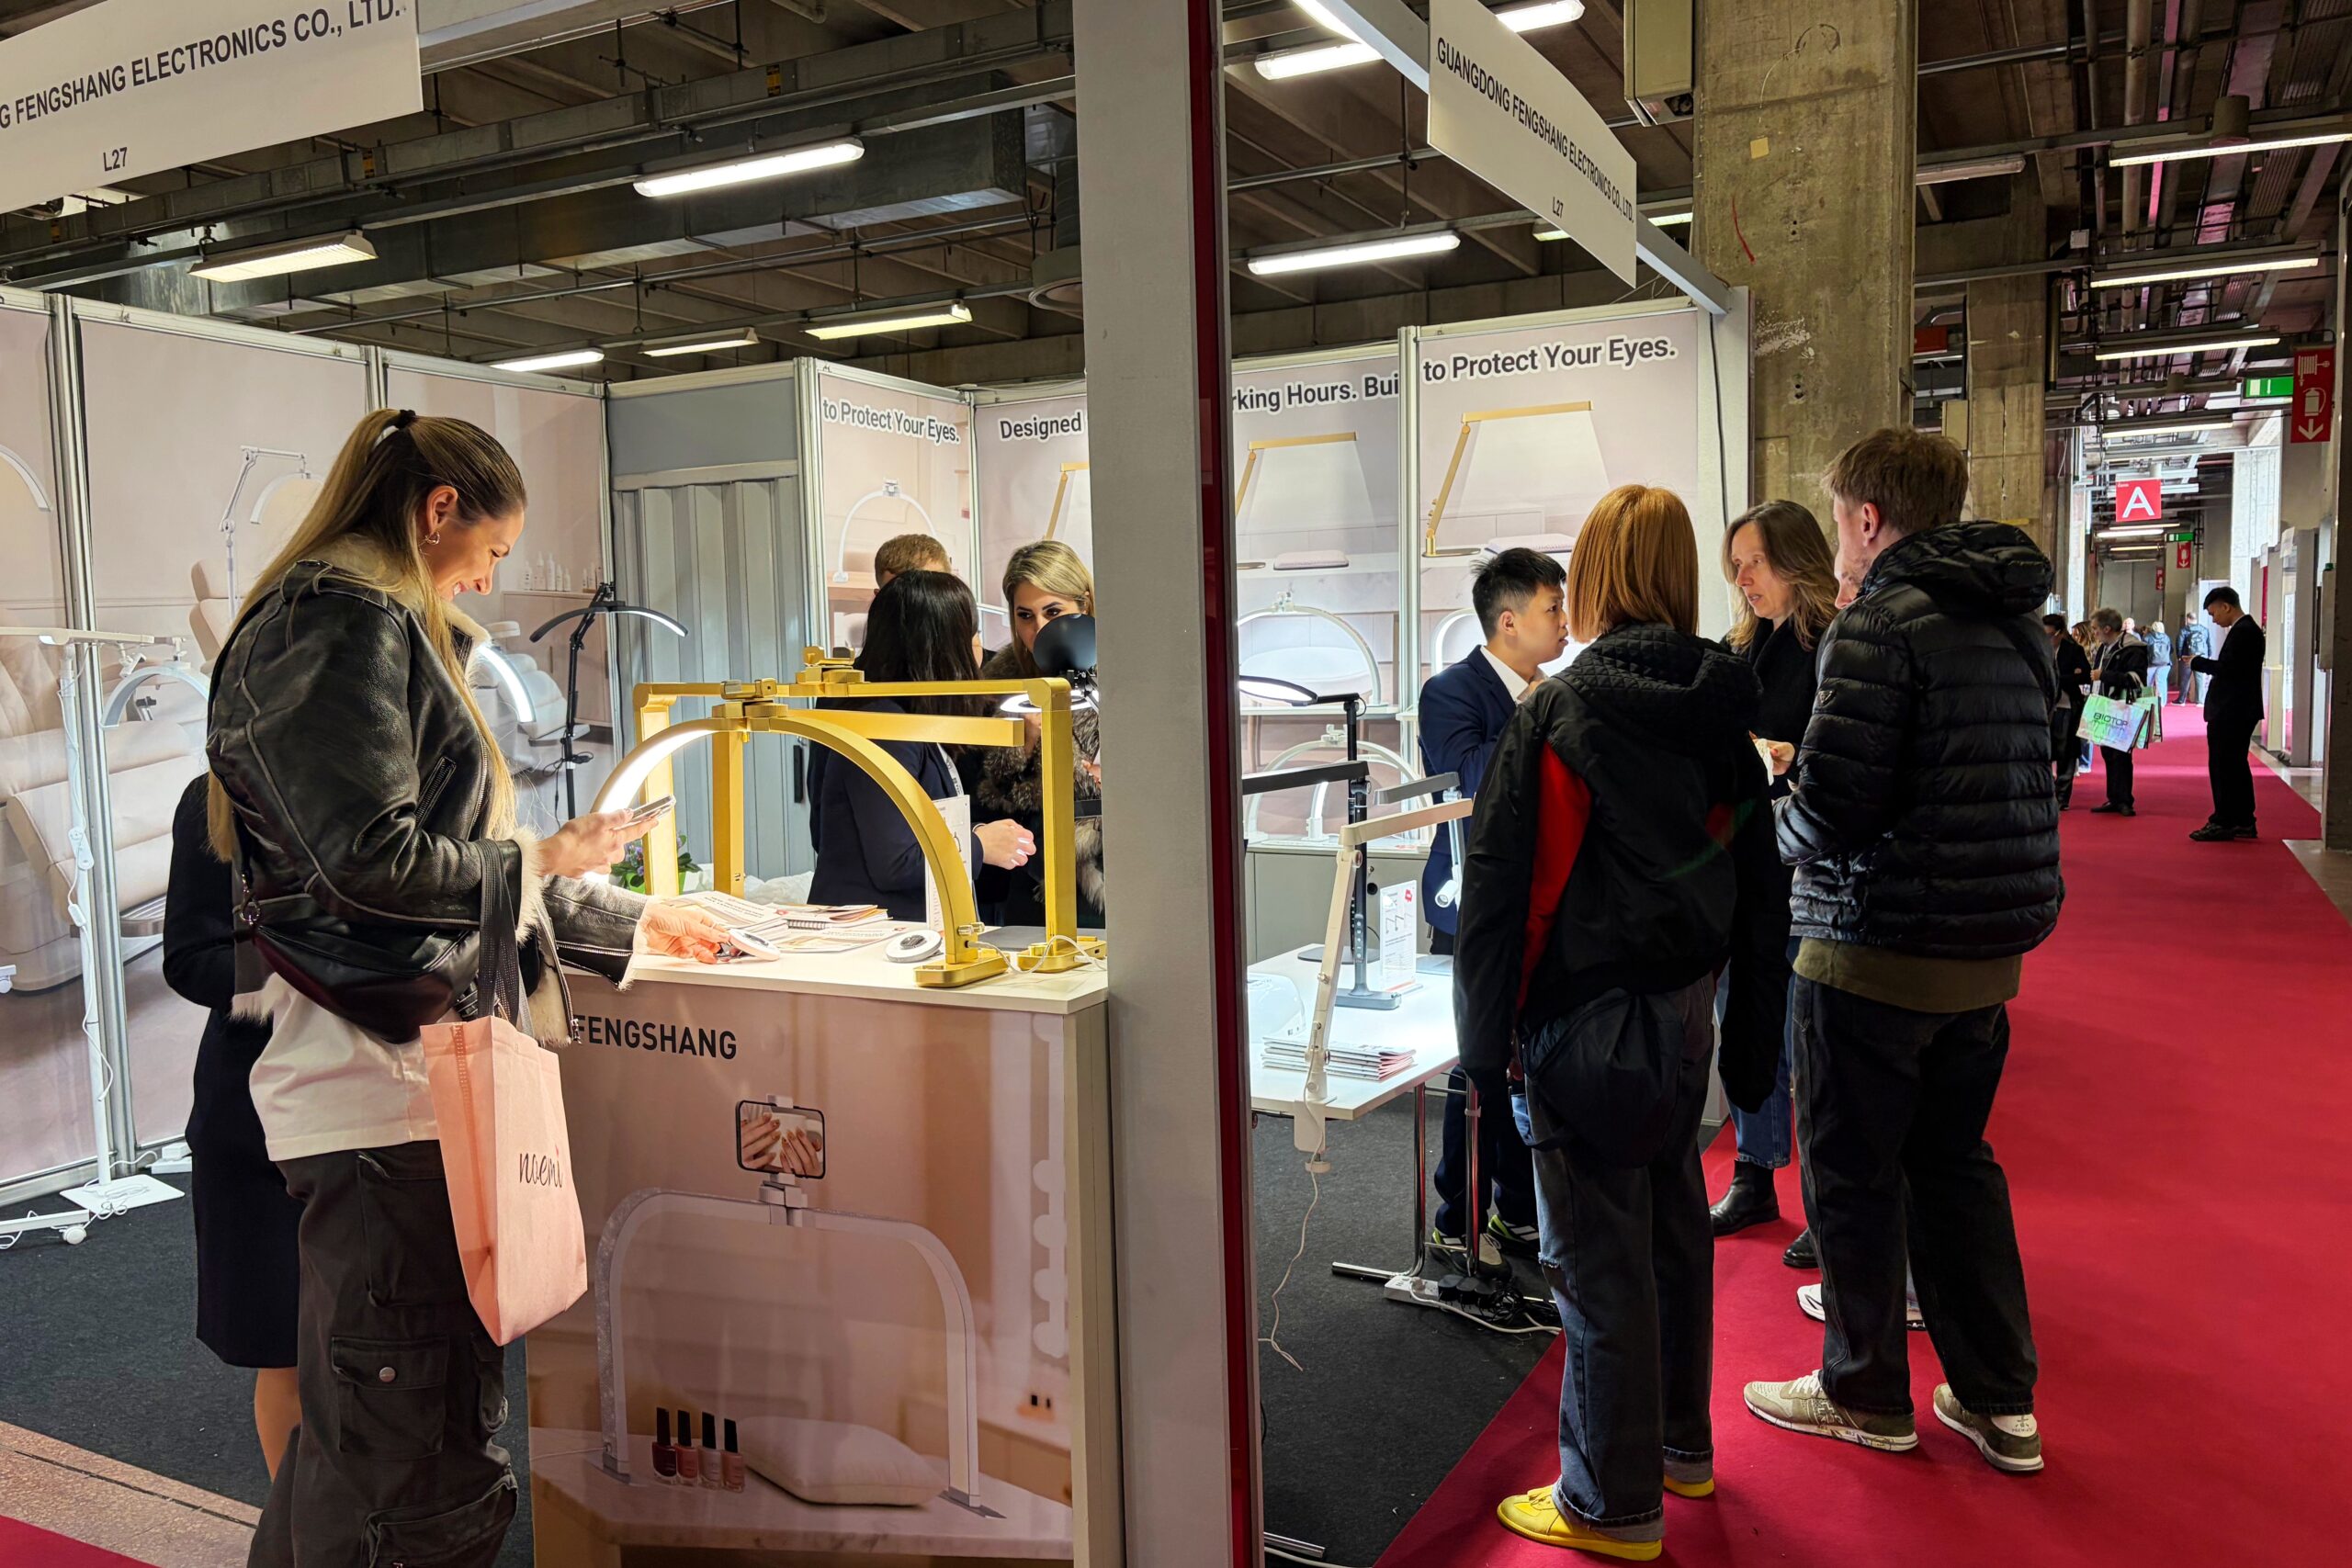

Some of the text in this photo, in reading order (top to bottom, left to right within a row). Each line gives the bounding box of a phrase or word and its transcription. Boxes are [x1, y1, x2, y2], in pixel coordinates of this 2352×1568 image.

[15, 65, 126, 125] FENGSHANG
[132, 19, 287, 87] ELECTRONICS
[293, 8, 342, 41] CO.,
[348, 0, 401, 28] LTD.
[1437, 37, 1510, 112] GUANGDONG
[1512, 95, 1567, 158] FENGSHANG
[1569, 141, 1611, 200] ELECTRONICS
[103, 147, 129, 172] L27
[1552, 196, 1564, 220] L27
[1423, 337, 1677, 382] to Protect Your Eyes.
[1287, 384, 1357, 404] Hours.
[823, 400, 960, 444] to Protect Your Eyes.
[1000, 412, 1082, 439] Designed
[2121, 485, 2155, 519] A
[519, 1145, 563, 1189] noemi
